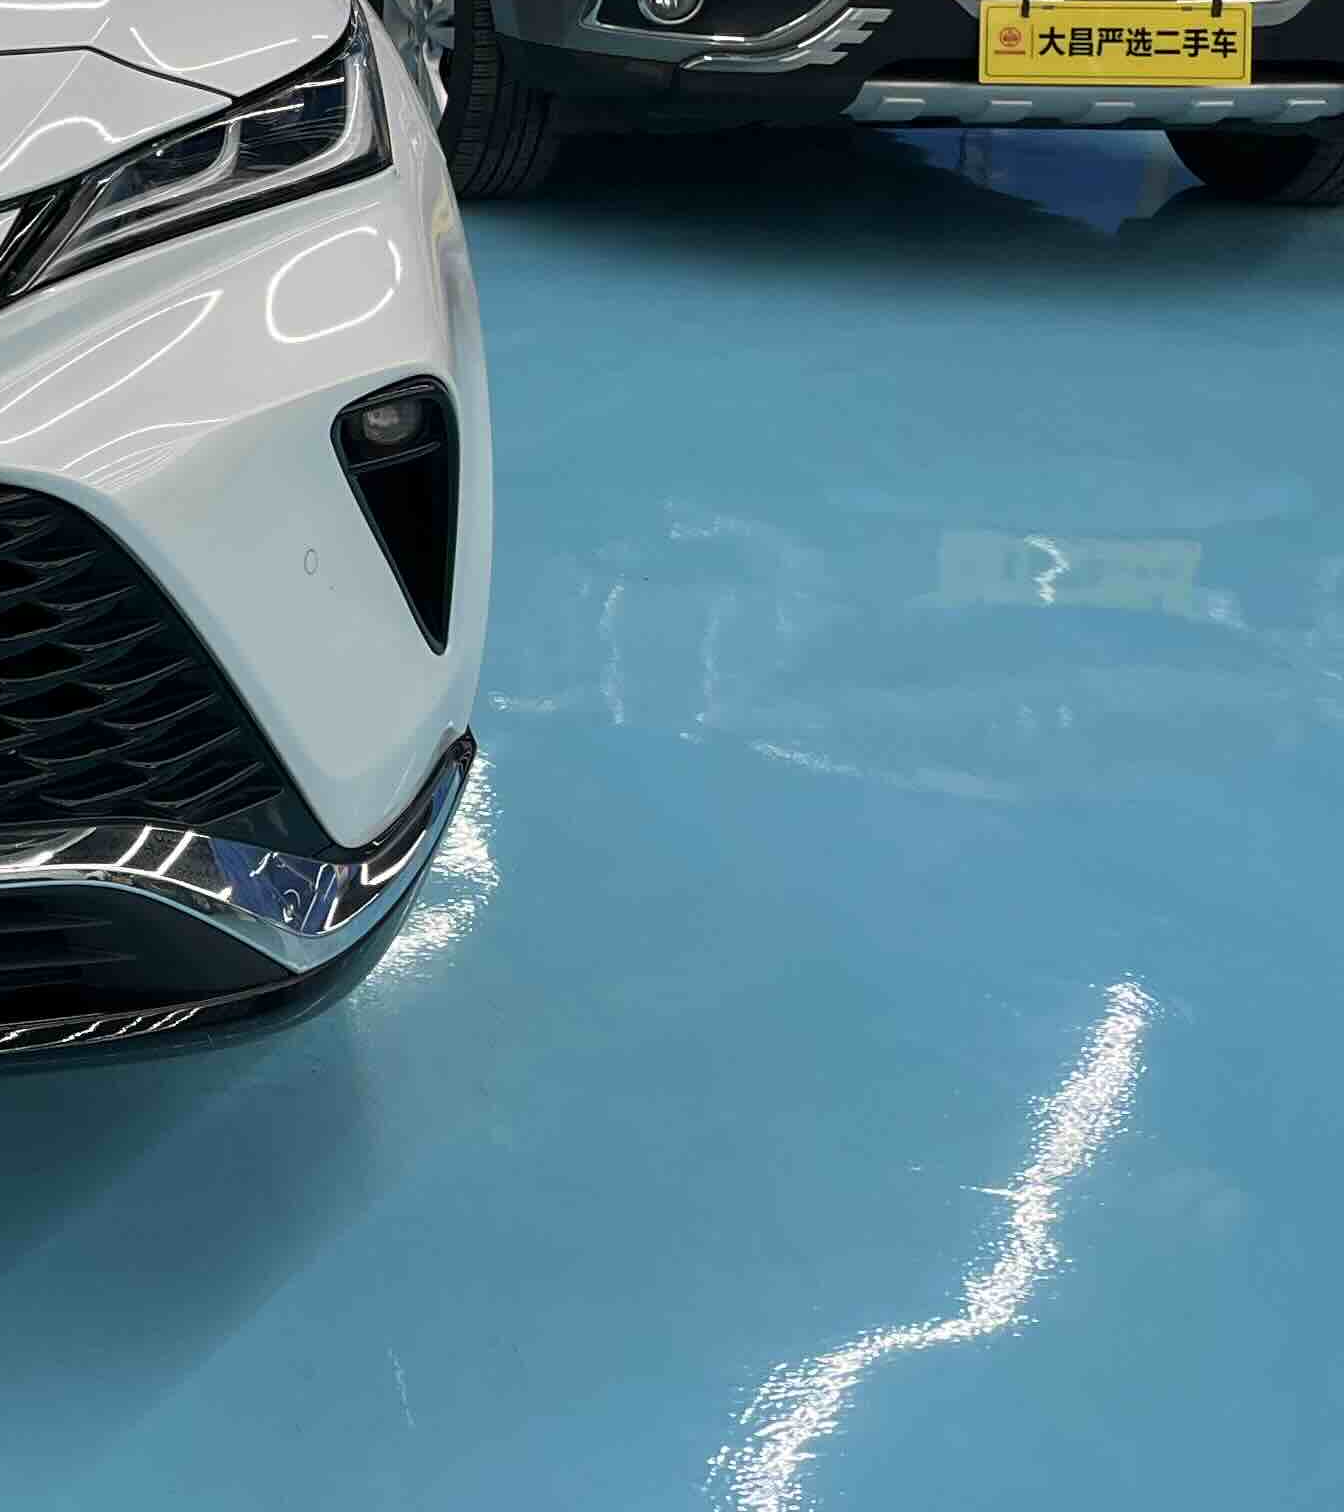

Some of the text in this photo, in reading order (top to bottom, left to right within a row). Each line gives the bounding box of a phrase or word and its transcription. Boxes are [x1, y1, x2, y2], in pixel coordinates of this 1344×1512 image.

[1038, 26, 1238, 58] 大昌严选二手车
